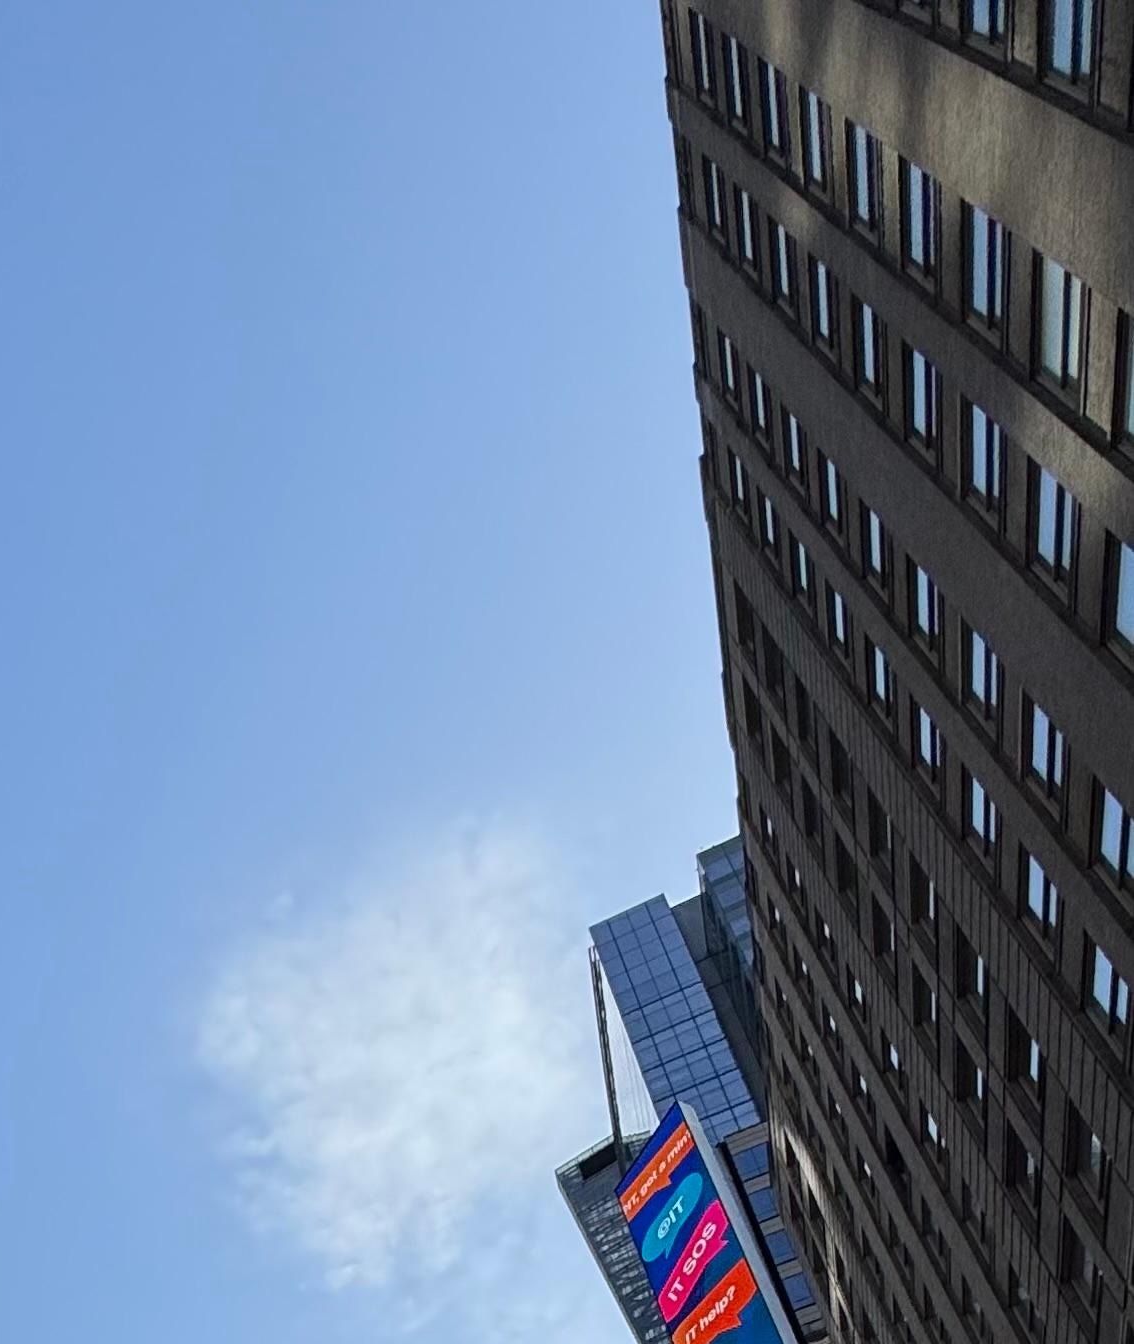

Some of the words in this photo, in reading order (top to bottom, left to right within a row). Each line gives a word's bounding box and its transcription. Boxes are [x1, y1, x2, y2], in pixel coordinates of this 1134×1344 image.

[657, 1195, 684, 1240] @IT
[667, 1282, 684, 1302] IT
[682, 1221, 717, 1276] SOS
[699, 1285, 737, 1331] help?
